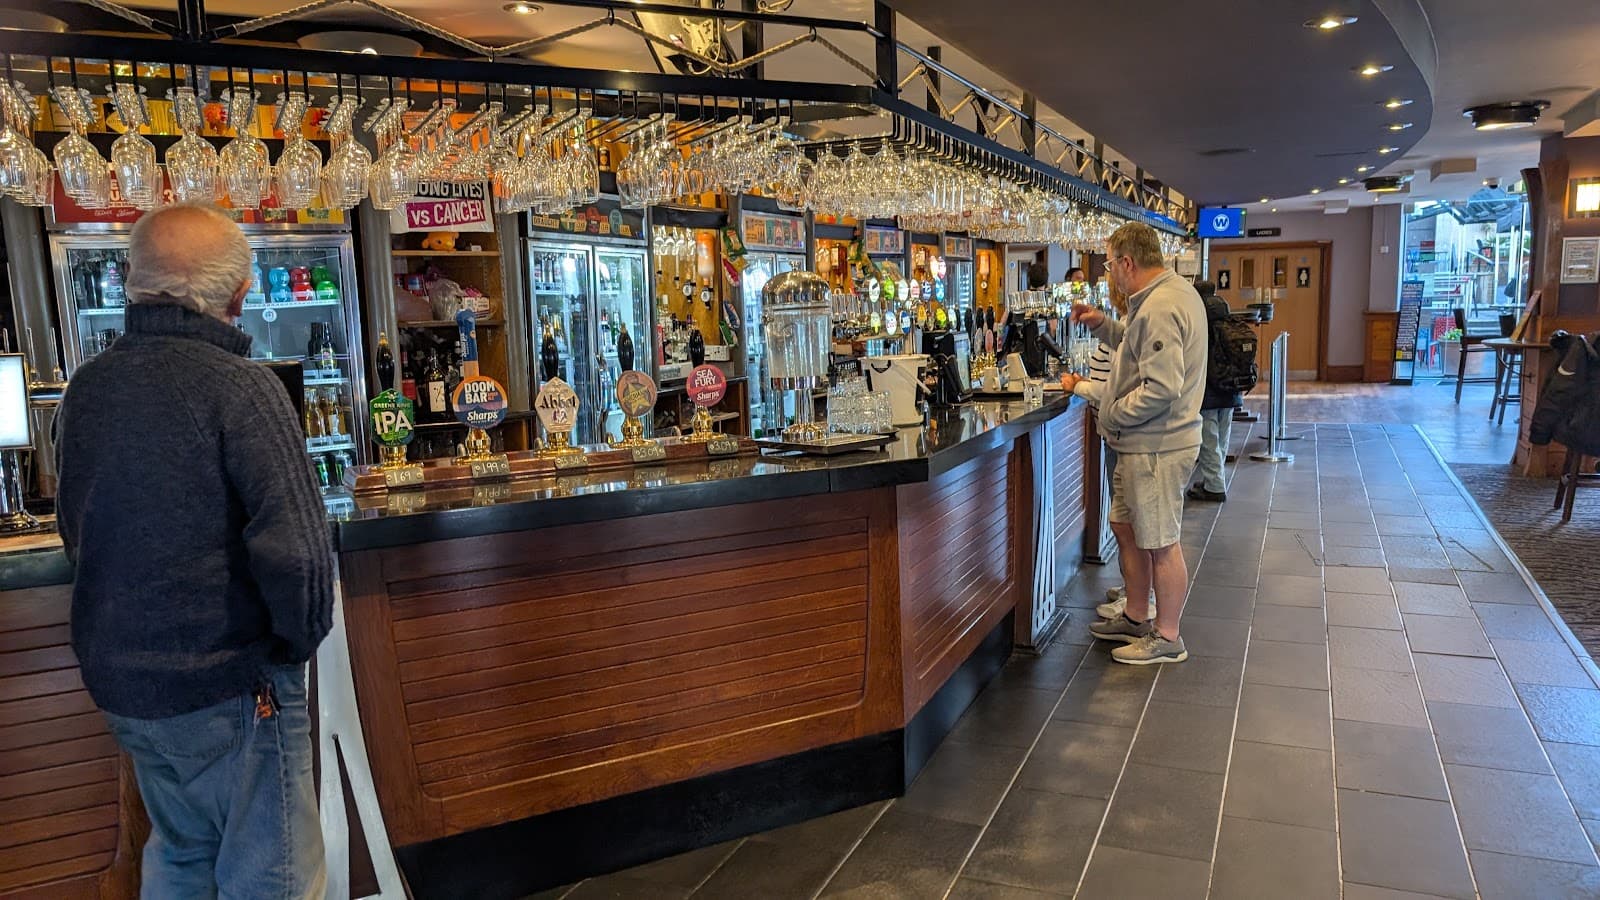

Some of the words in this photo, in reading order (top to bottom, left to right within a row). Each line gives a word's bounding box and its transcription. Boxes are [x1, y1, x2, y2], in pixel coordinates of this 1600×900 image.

[452, 181, 483, 198] LIVES
[434, 199, 485, 224] CANCER
[696, 369, 714, 379] SEA
[464, 380, 496, 393] DOOM
[695, 376, 716, 388] FURY
[465, 392, 488, 404] BAR
[373, 410, 413, 435] IPA
